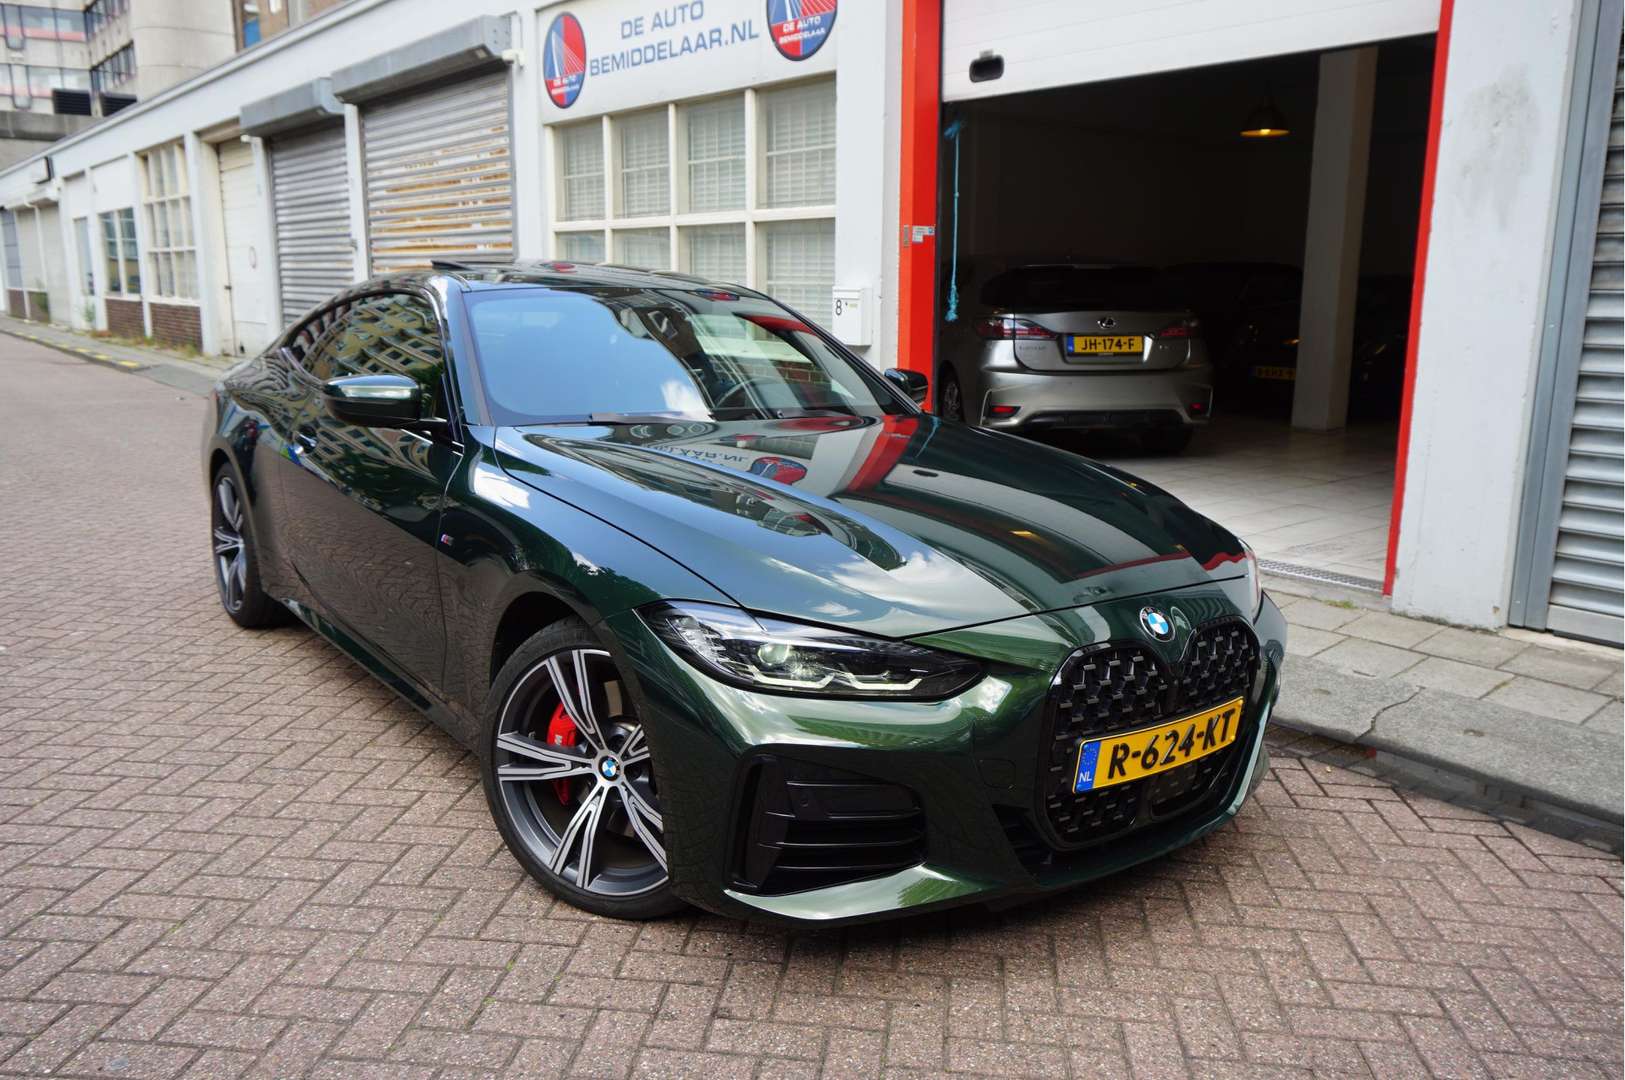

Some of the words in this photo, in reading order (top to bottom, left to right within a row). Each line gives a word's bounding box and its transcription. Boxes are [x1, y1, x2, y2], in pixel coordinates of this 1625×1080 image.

[621, 17, 644, 38] DE
[651, 1, 704, 29] AUTO
[590, 20, 759, 76] BEMIDDELAAR.NL
[836, 299, 842, 315] 8
[1082, 337, 1135, 350] JH-174-F
[1107, 709, 1235, 779] R-624-KT
[1079, 771, 1093, 783] NL
